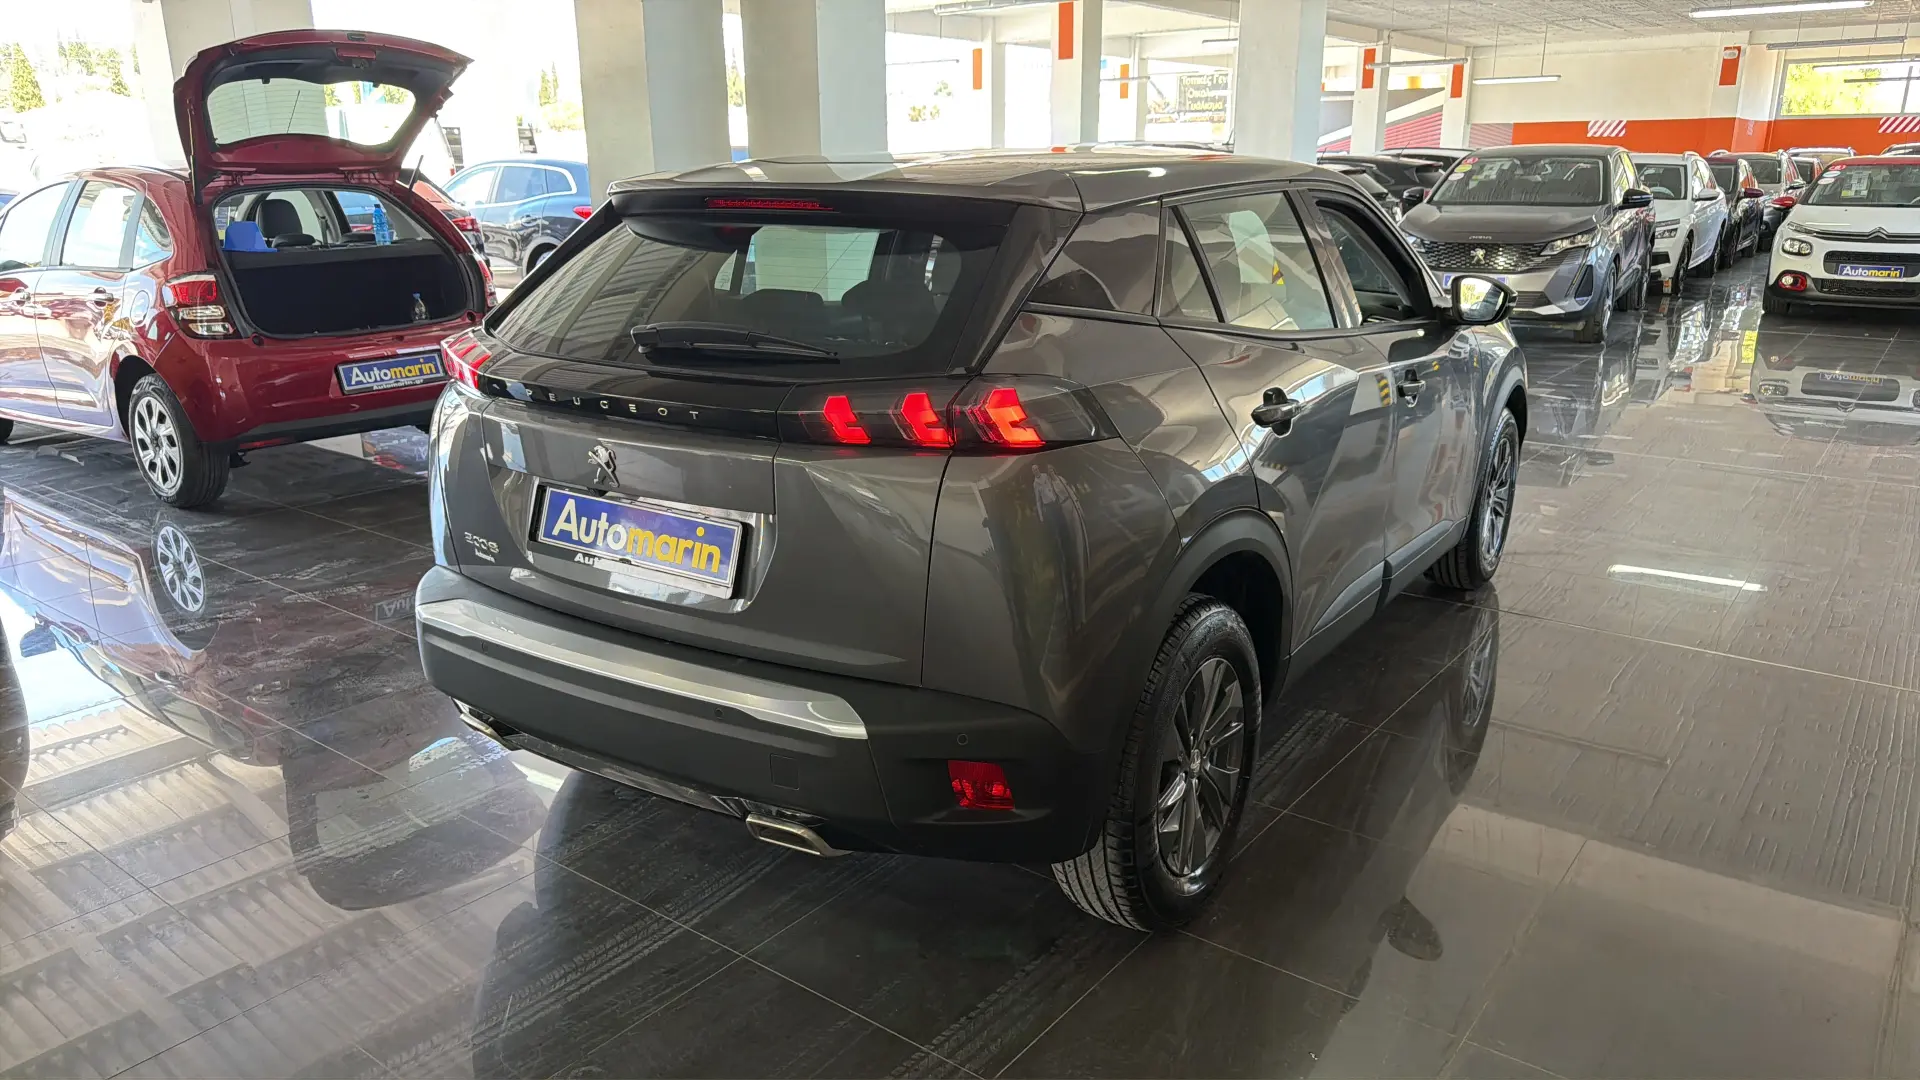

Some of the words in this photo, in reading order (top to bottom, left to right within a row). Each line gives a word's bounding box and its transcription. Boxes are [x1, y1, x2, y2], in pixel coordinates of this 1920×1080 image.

[1842, 266, 1901, 278] Automarin
[351, 358, 437, 385] Automarin
[373, 378, 424, 391] Automarin.gr
[526, 388, 699, 420] PEUGEOT
[551, 498, 722, 573] Automarin
